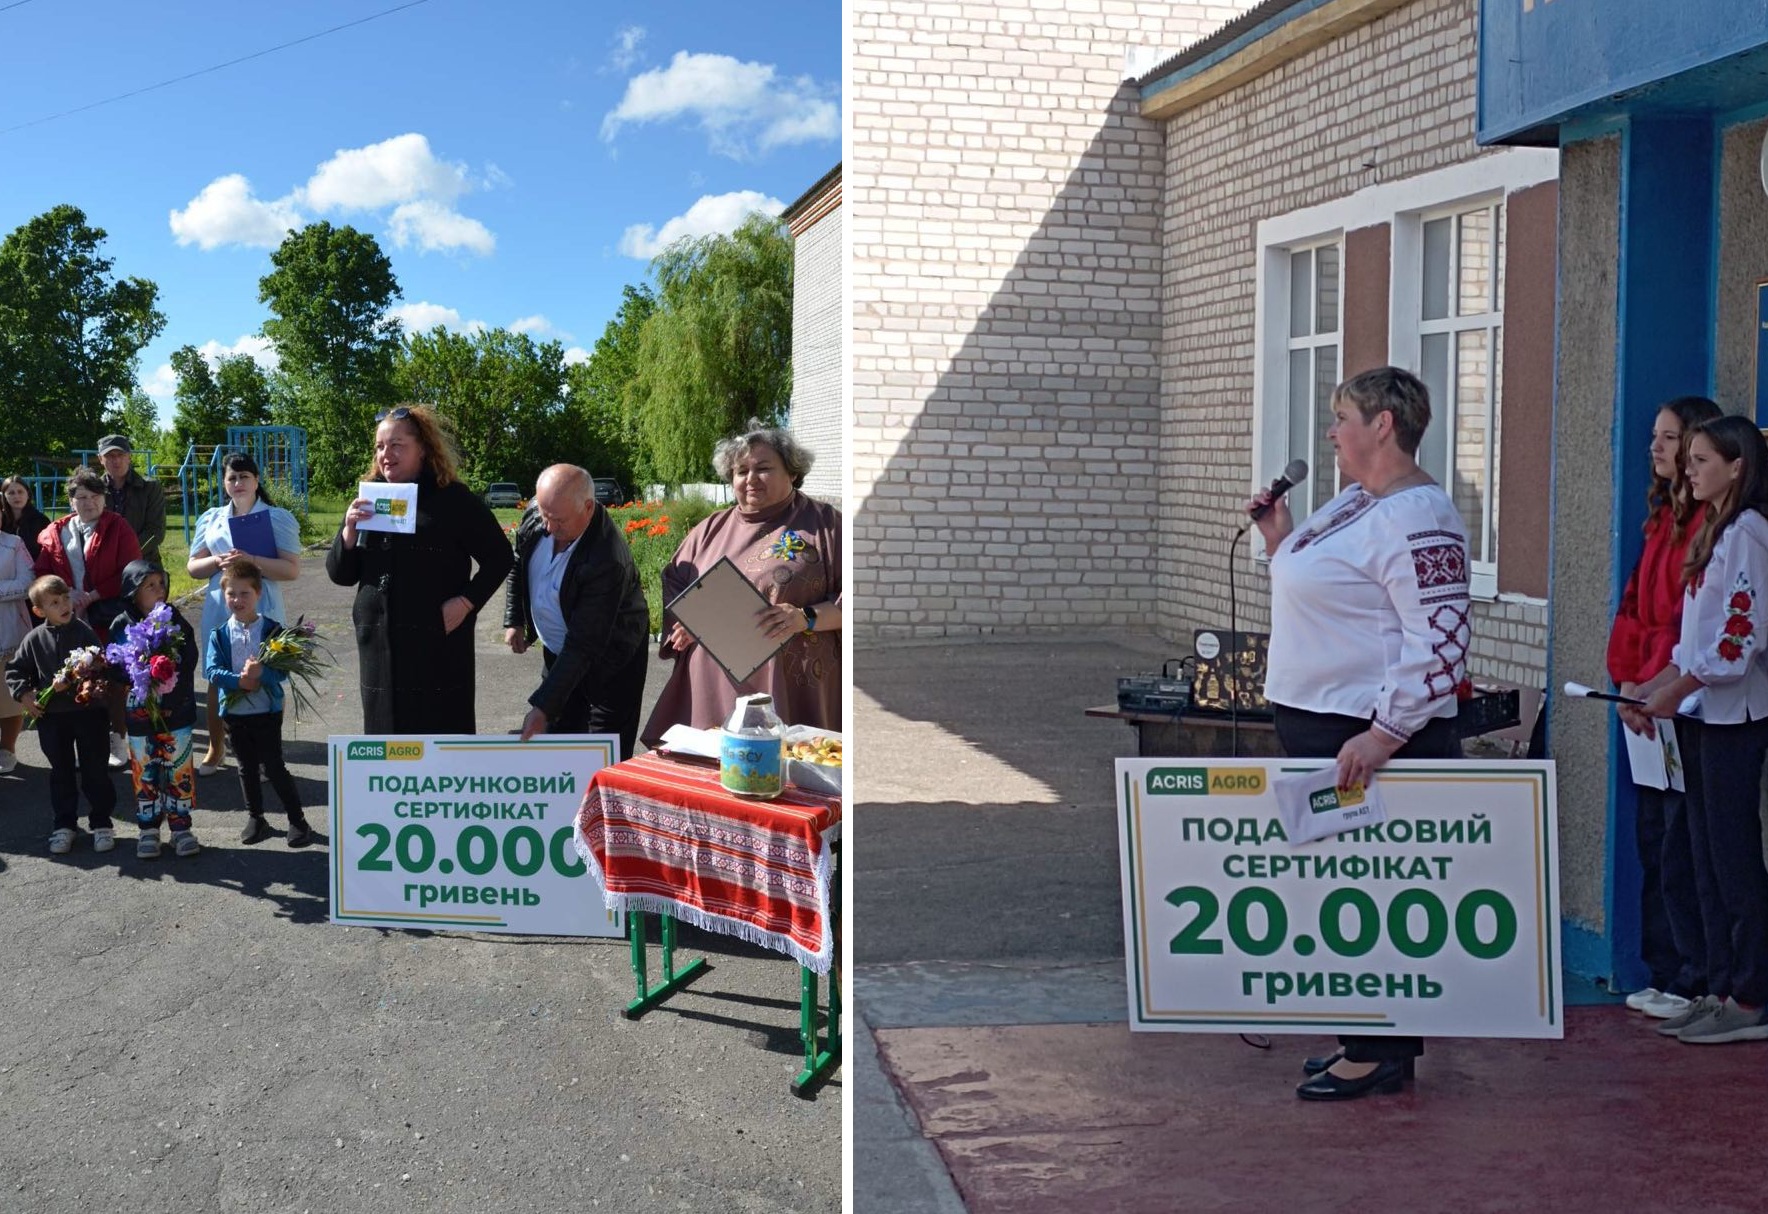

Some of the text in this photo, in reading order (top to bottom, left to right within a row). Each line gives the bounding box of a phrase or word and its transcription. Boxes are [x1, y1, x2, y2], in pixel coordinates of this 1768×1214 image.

[350, 746, 421, 756] ACRIS AGRO
[368, 771, 576, 795] ПОДАРУНКОВИЙ
[1151, 774, 1261, 789] ACRIS AGRO
[393, 801, 549, 821] СЕРТИФІКАТ
[1312, 793, 1337, 809] ACRIS
[1182, 813, 1492, 846] ПОДАНКОВИЙ
[1222, 854, 1454, 881] СЕРТИФІКАТ
[403, 883, 541, 908] гривень
[1164, 885, 1518, 960] 20.000
[1241, 970, 1444, 1005] гривень
